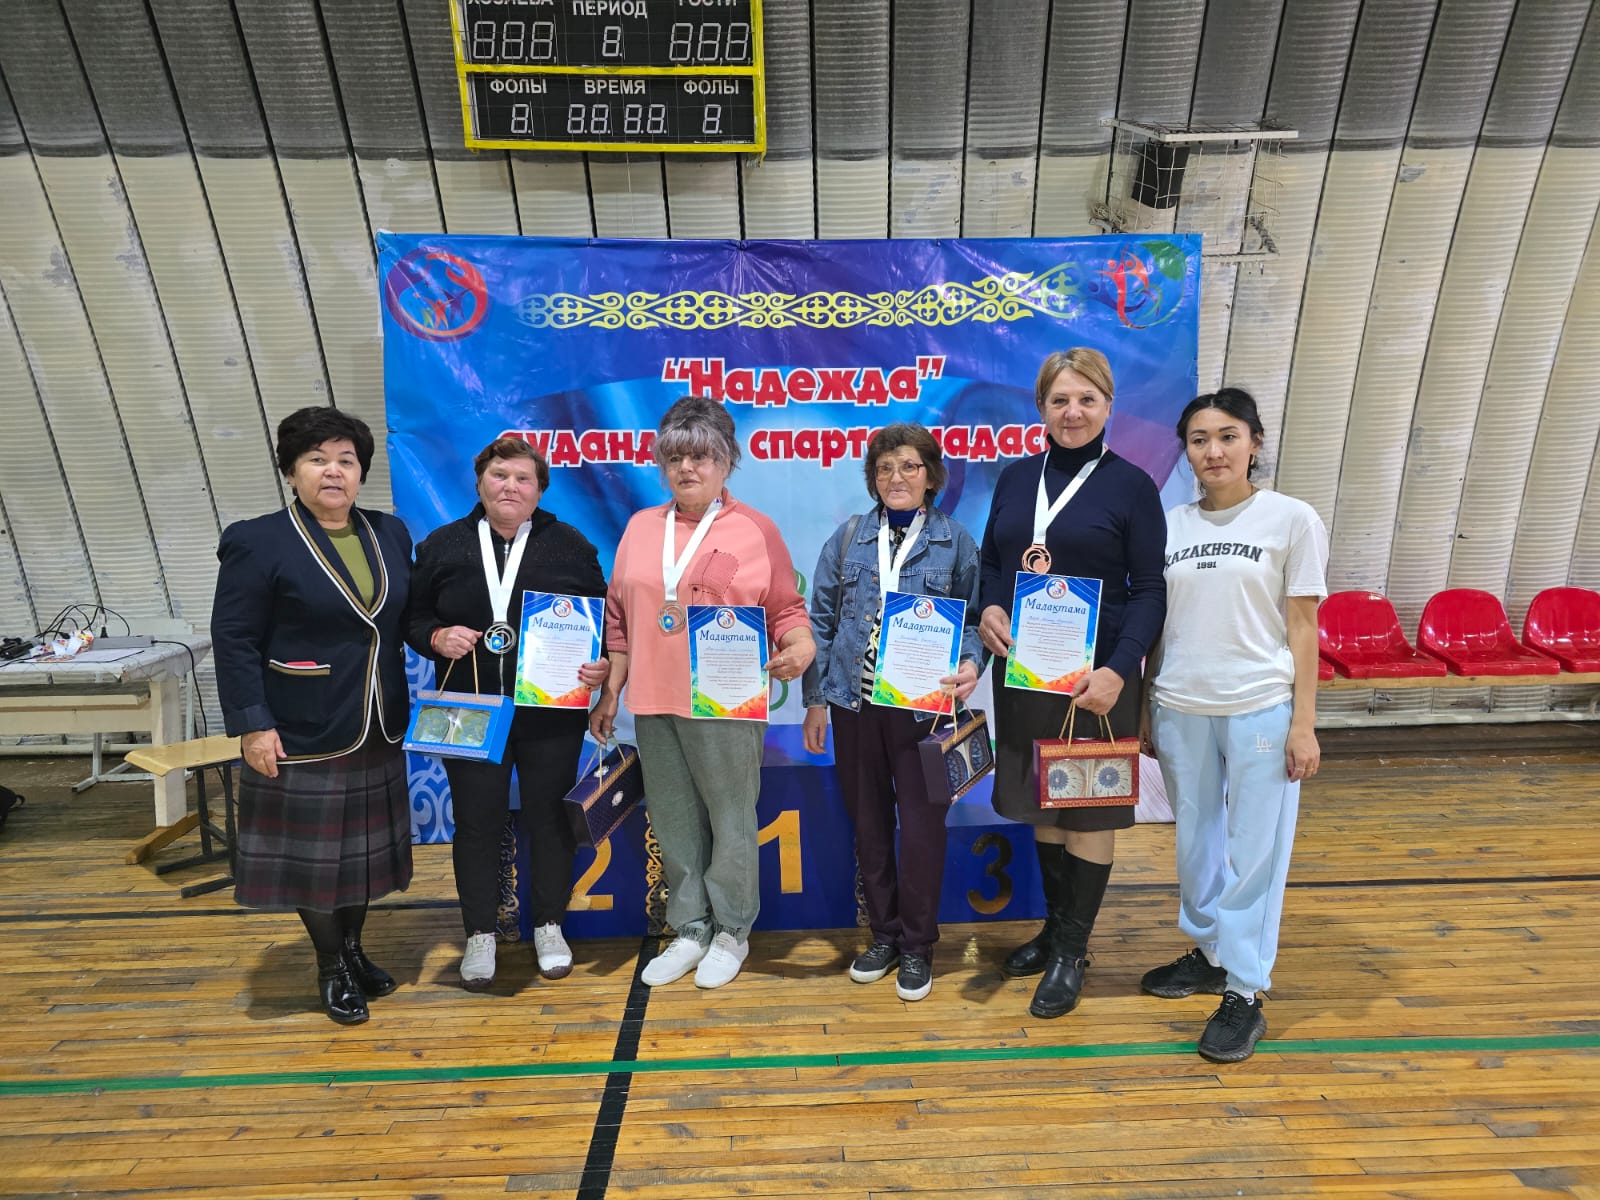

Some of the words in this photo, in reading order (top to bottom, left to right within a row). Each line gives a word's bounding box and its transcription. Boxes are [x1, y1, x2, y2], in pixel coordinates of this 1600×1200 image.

[573, 0, 648, 19] ПЕРИОД
[490, 78, 547, 94] ФОЛЫ
[584, 79, 646, 95] ВРЕМЯ
[683, 79, 739, 95] ФОЛЫ
[1025, 598, 1087, 614] Мадақтама
[893, 616, 951, 634] Мадақтама
[699, 630, 757, 643] Мадақтама
[757, 809, 803, 894] 1
[566, 838, 614, 911] 2
[967, 832, 1013, 914] 3
